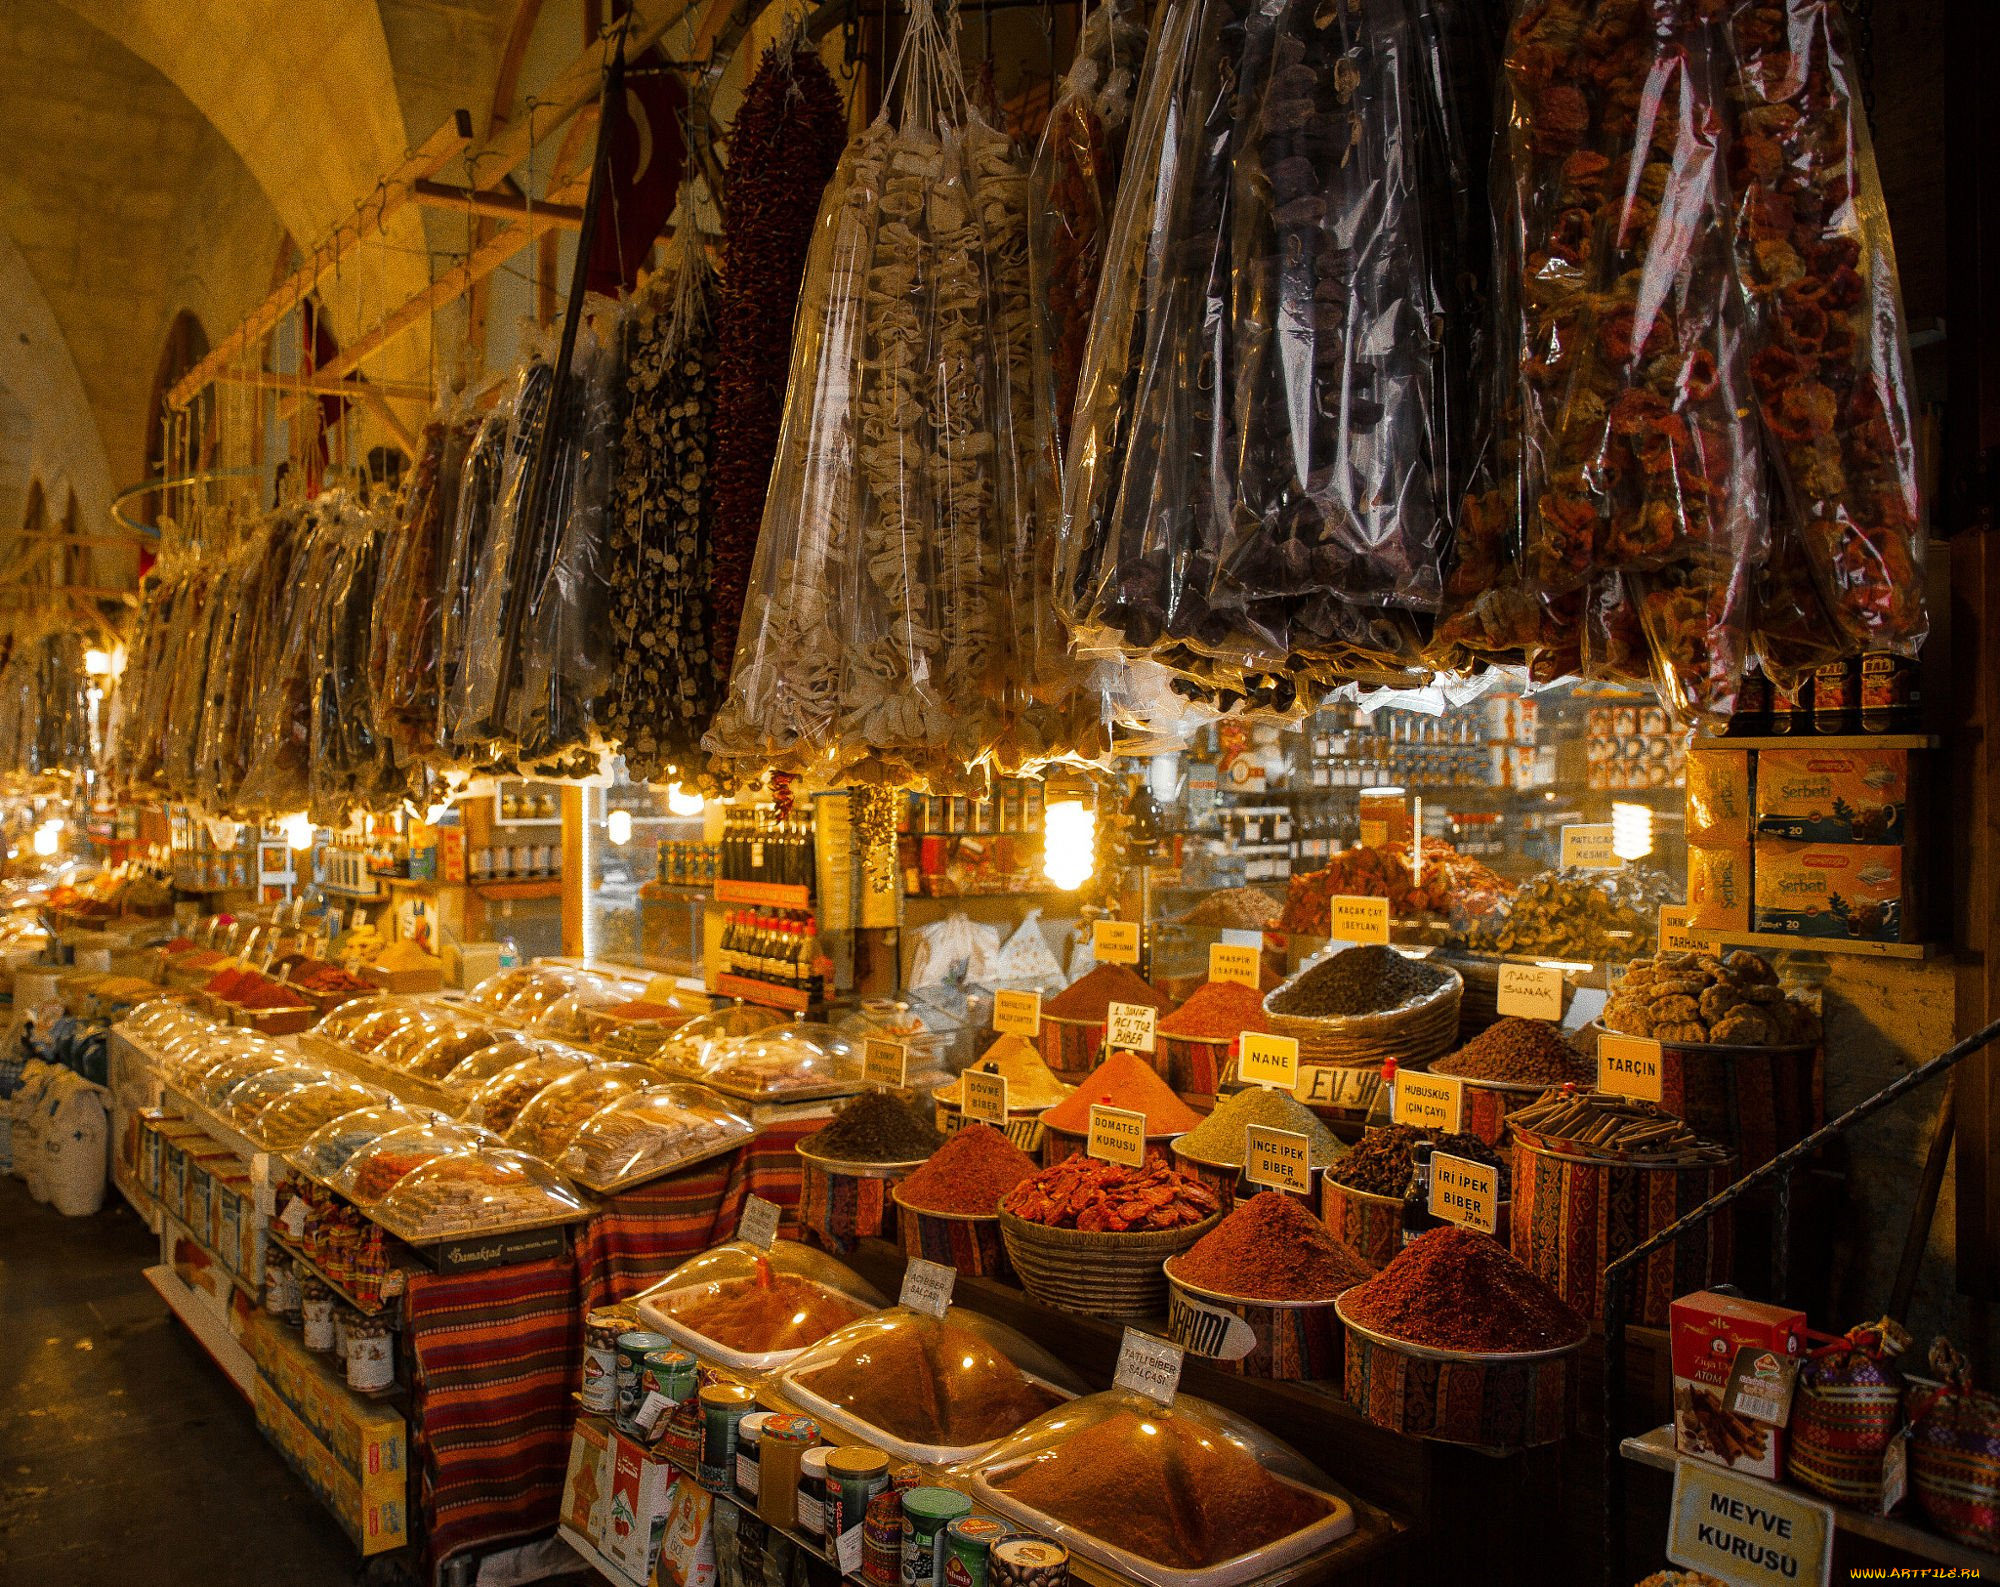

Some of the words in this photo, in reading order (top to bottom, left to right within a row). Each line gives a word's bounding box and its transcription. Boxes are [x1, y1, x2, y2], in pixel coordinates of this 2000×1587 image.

[1789, 826, 1803, 836] 20
[1786, 919, 1800, 930] 20
[1252, 1052, 1289, 1069] NANE
[970, 1083, 1000, 1096] DÖVME
[1095, 1117, 1140, 1136] DOMATES
[1096, 1136, 1136, 1152] KURUSU
[1253, 1137, 1277, 1154] İNCE
[1280, 1143, 1304, 1161] İPEK
[1263, 1159, 1294, 1177] BİBER
[1438, 1169, 1455, 1191] İRİ
[1458, 1172, 1488, 1195] İPEK
[1443, 1191, 1481, 1213] BİBER
[1127, 1363, 1166, 1386] SALÇASI
[1148, 1357, 1177, 1376] BİBER
[1694, 1369, 1722, 1385] ATOM
[1710, 1493, 1793, 1540] MEYVE
[1697, 1523, 1798, 1579] KURUSU
